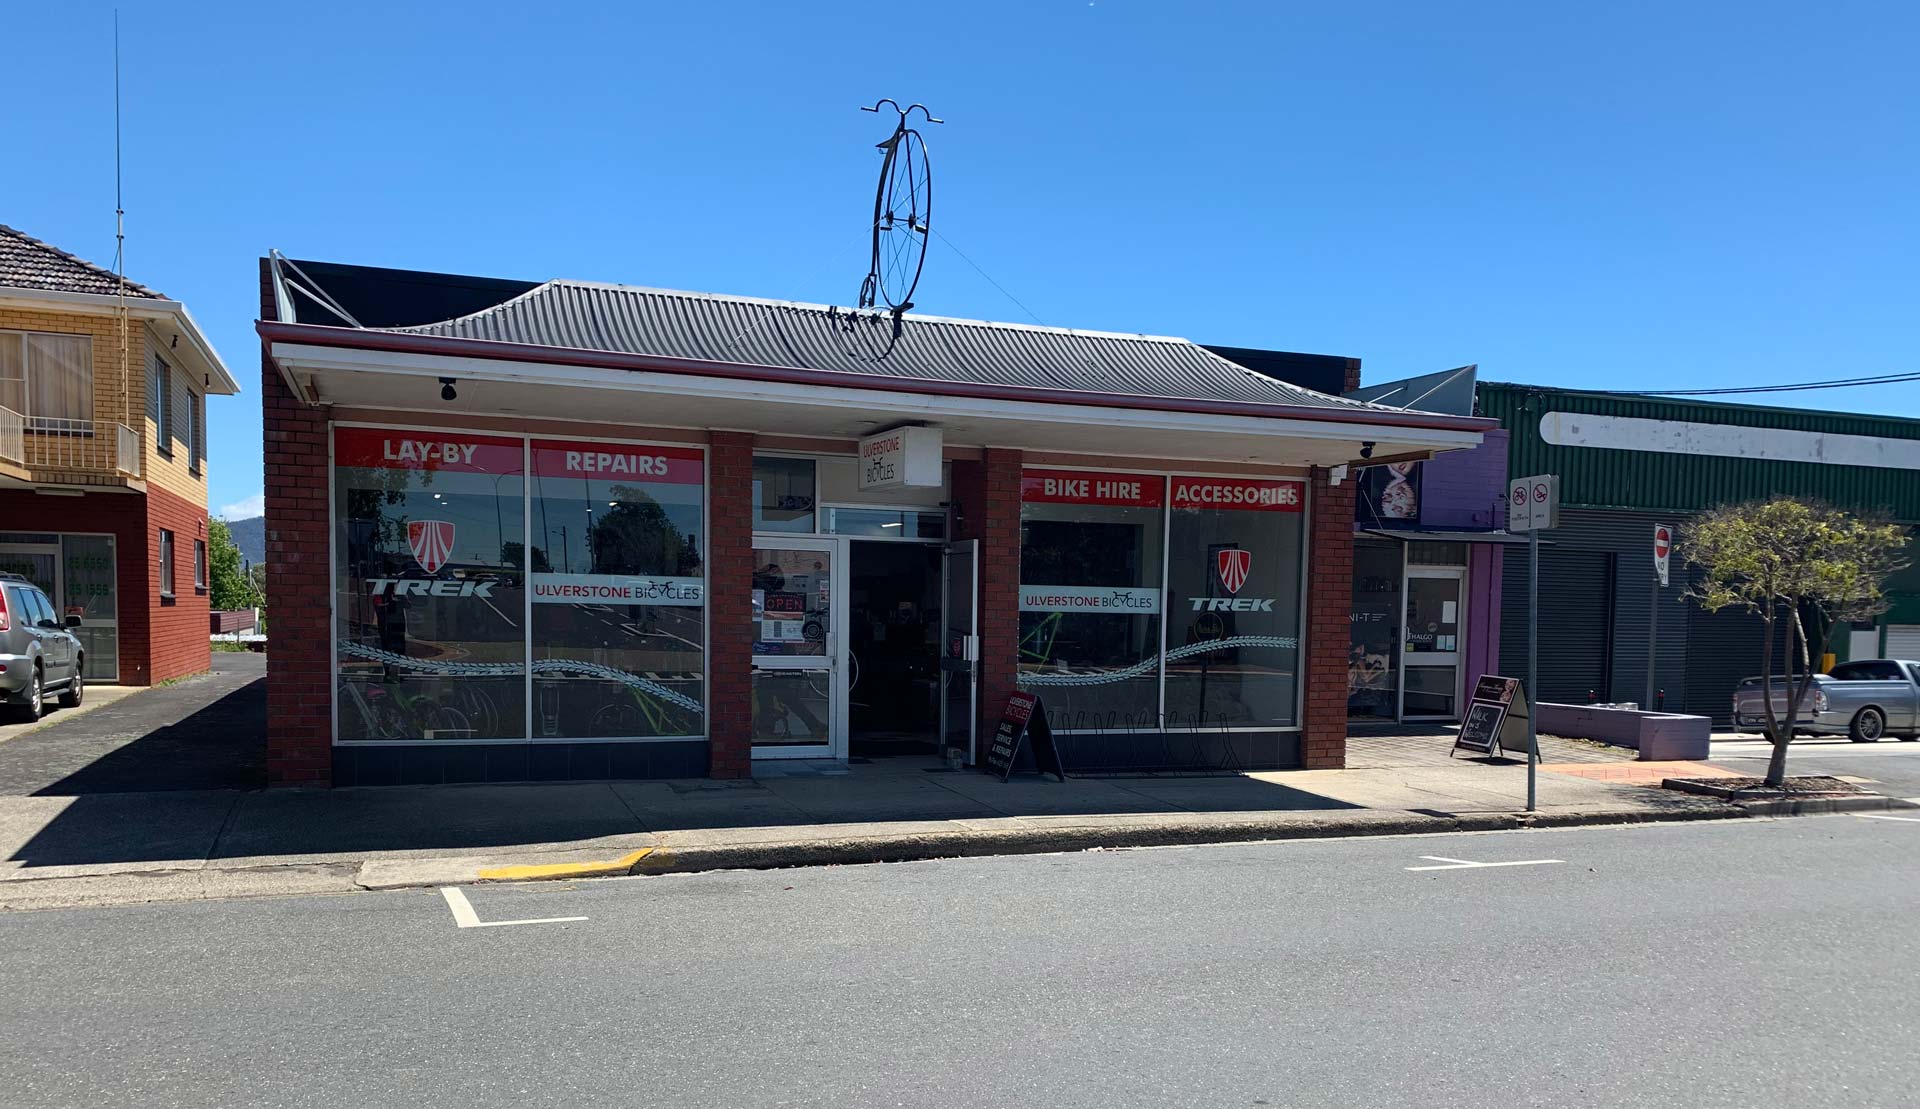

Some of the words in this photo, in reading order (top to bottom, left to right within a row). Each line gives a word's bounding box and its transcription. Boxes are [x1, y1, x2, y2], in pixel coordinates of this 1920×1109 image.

[383, 439, 478, 465] LAY-BY
[863, 436, 900, 458] ULVERSTONE
[566, 451, 668, 476] REPAIRS
[867, 463, 895, 483] BICYCLES
[1044, 478, 1089, 498] BIKE
[1096, 480, 1141, 500] HIRE
[1175, 484, 1298, 506] ACCESSORIES
[365, 578, 498, 598] TREK
[535, 584, 632, 599] ULVERSTONE
[635, 584, 699, 600] BICYCLES
[766, 598, 803, 610] OPEN
[1026, 595, 1100, 608] ULVERSTONE
[1102, 596, 1152, 609] BICYCLES
[1188, 597, 1277, 612] TREK
